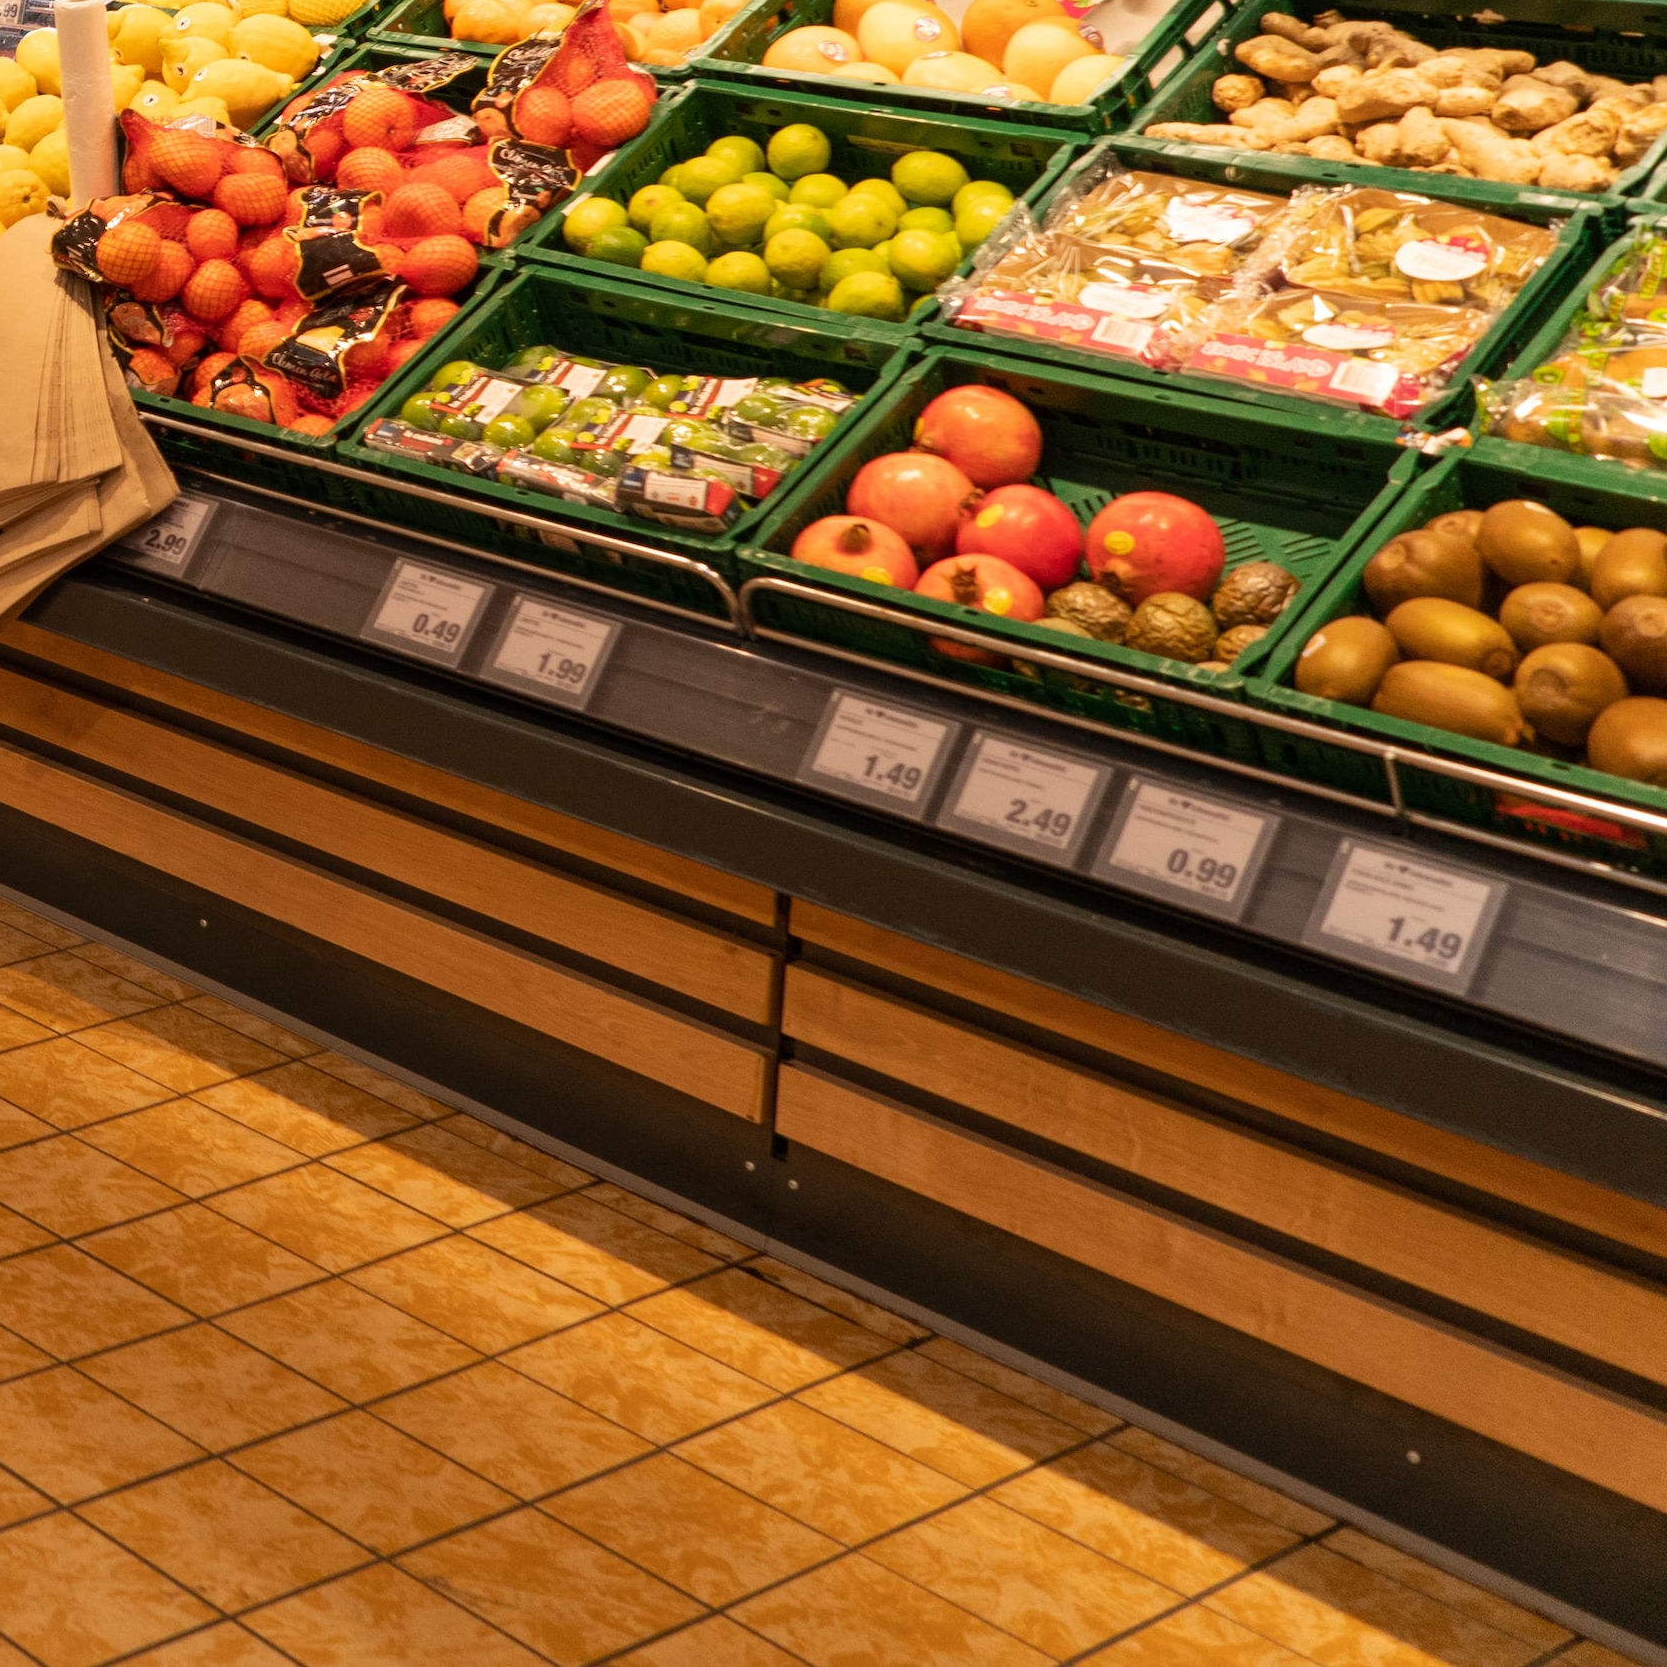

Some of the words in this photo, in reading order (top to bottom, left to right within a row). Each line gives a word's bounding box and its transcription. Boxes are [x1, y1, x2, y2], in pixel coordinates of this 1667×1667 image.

[144, 529, 188, 556] 2.99
[412, 613, 461, 642] 0.49
[537, 651, 586, 683] 1.99
[863, 755, 921, 790] 1.49
[1004, 798, 1071, 836] 2.49
[1166, 848, 1238, 888] 0.99
[1387, 916, 1462, 958] 1.49
